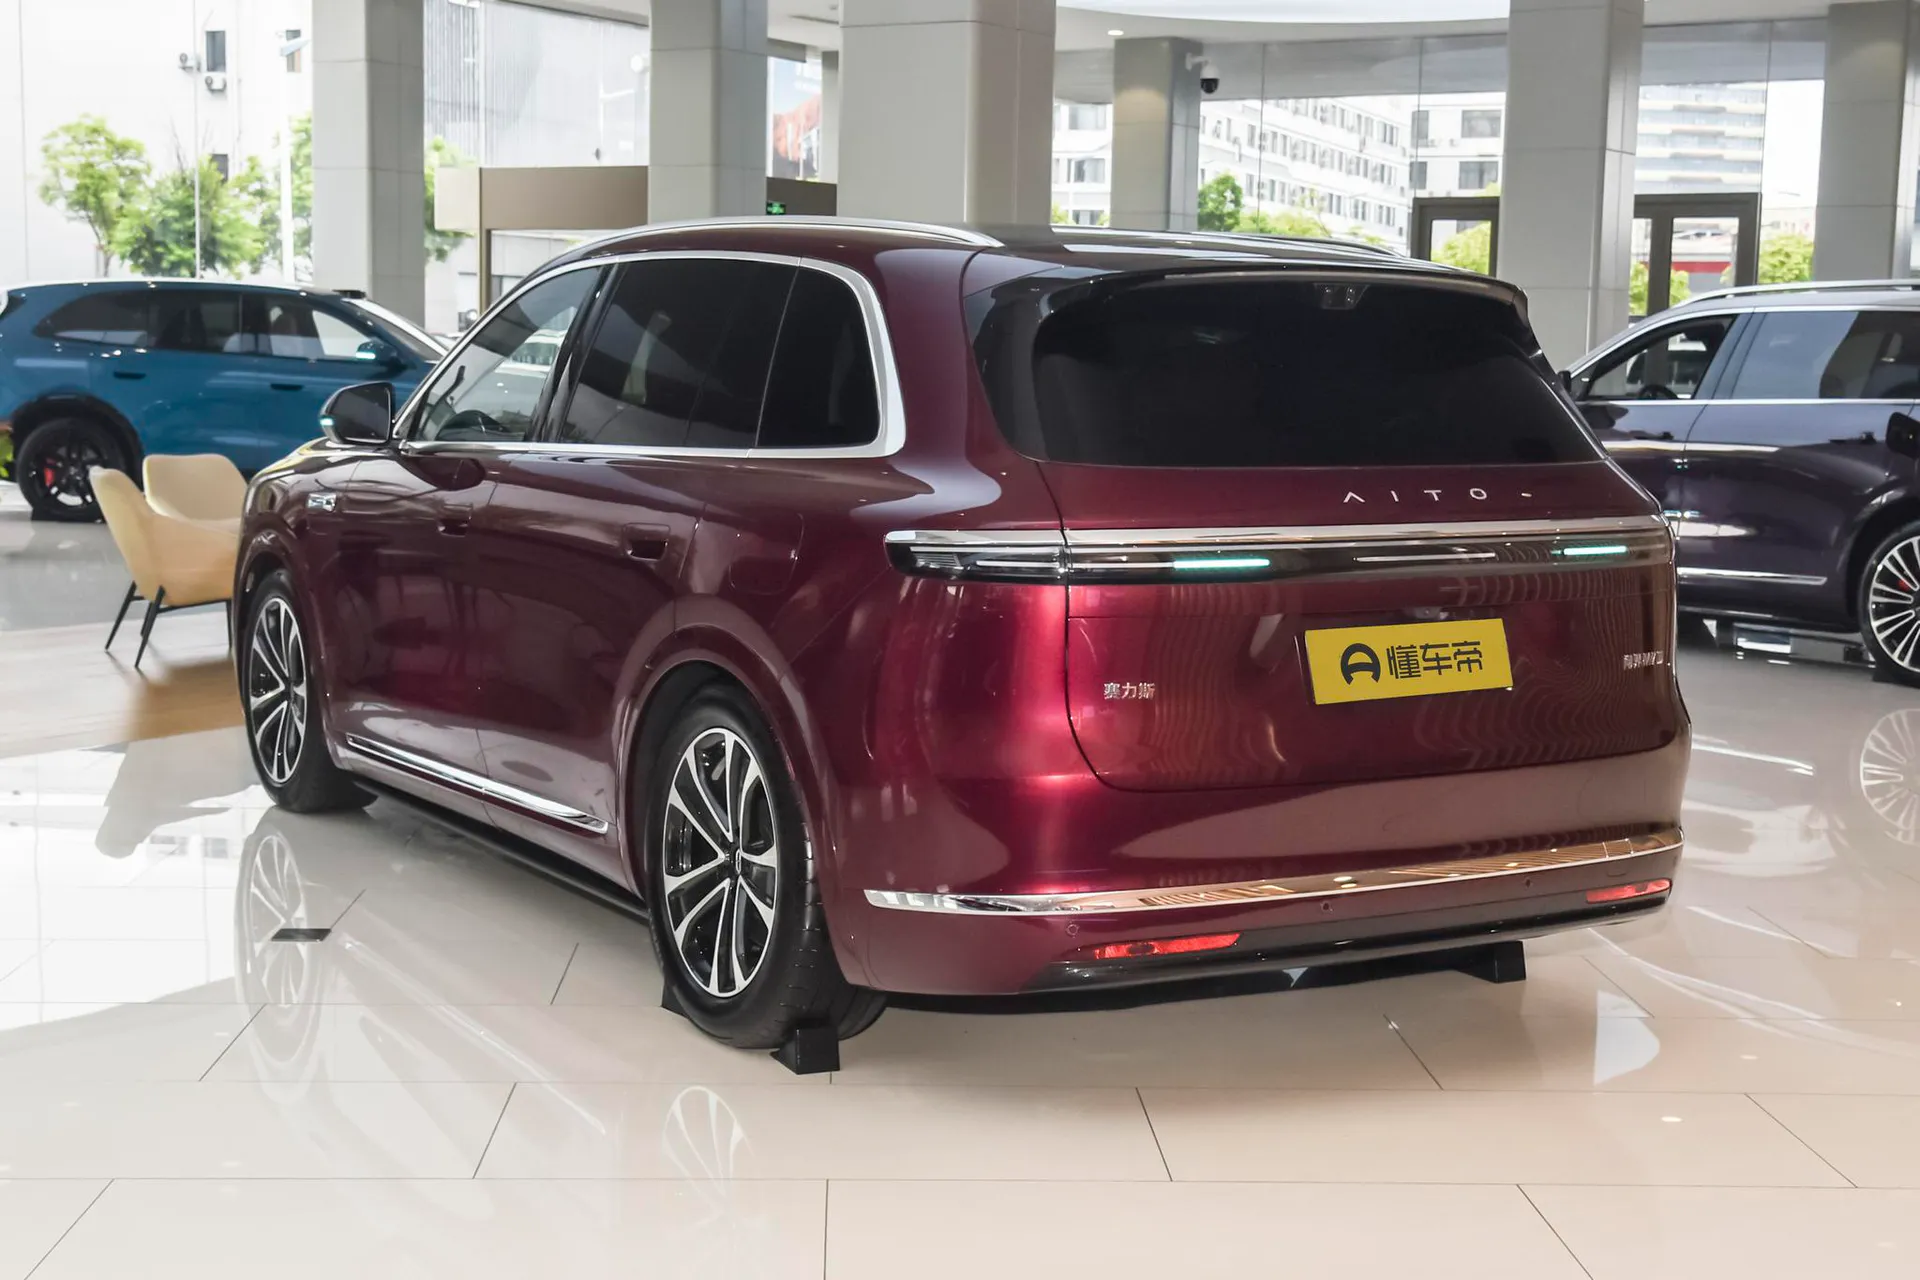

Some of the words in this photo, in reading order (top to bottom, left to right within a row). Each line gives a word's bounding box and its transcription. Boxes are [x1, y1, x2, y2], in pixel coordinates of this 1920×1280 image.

[1386, 641, 1483, 679] 懂车帝
[1103, 682, 1155, 700] 赛力斯
